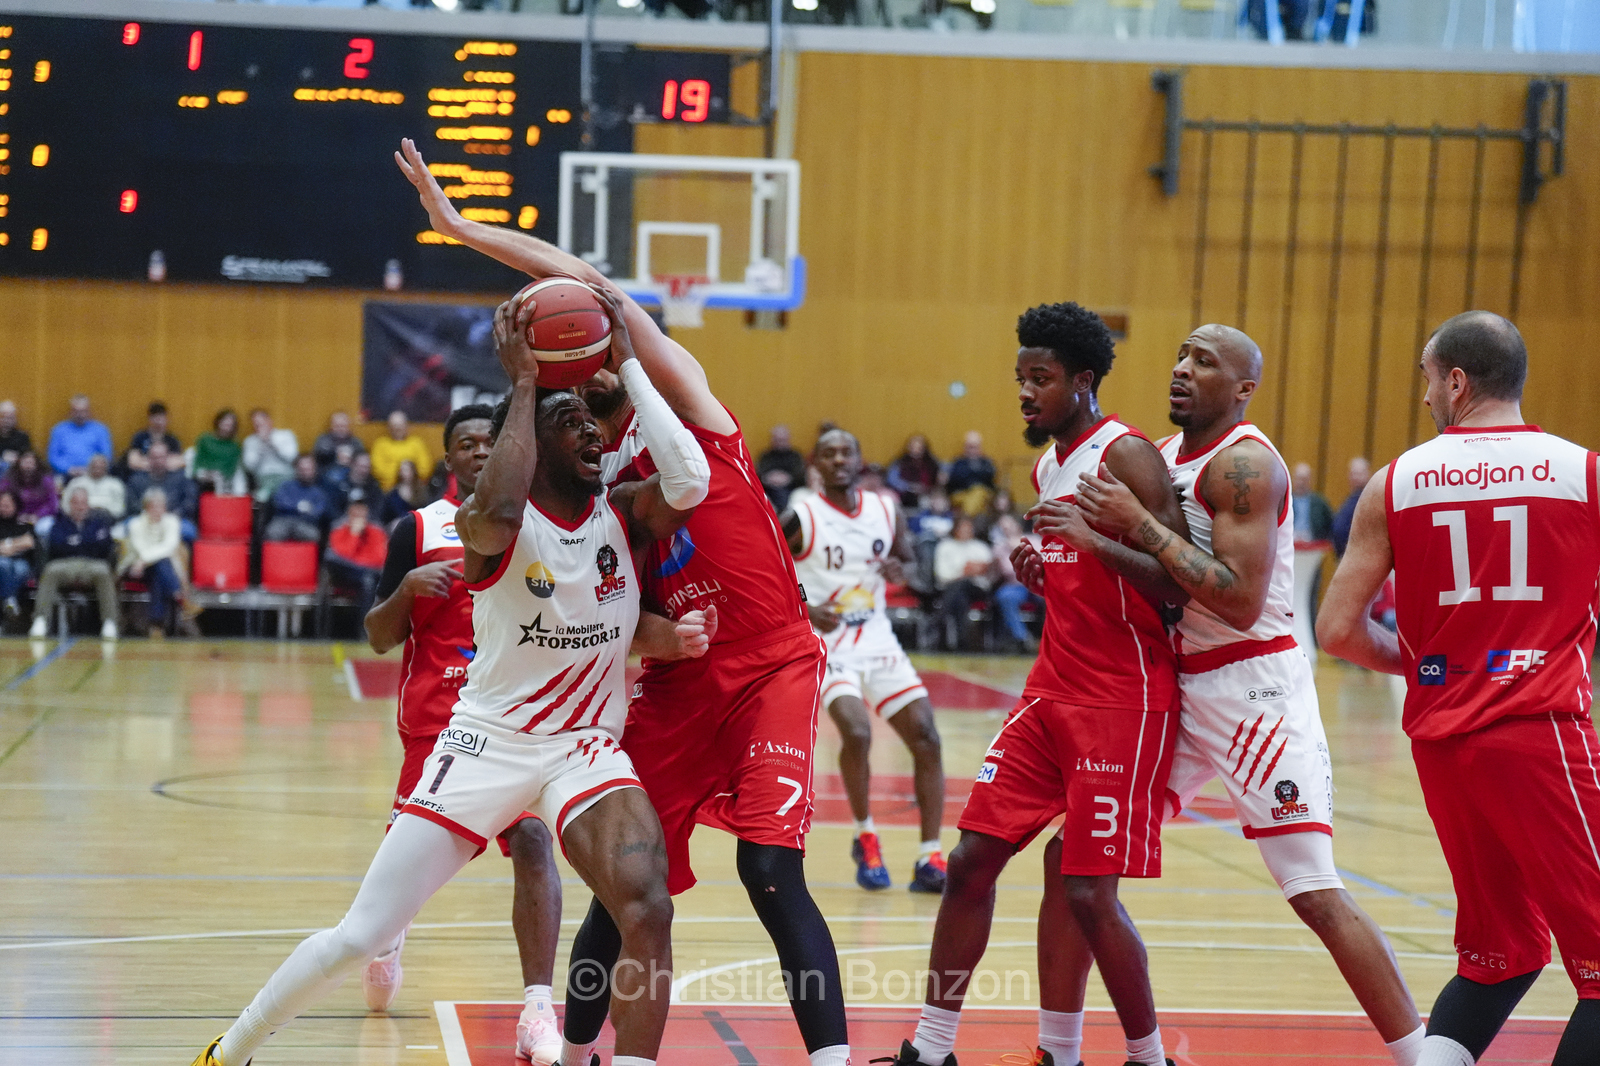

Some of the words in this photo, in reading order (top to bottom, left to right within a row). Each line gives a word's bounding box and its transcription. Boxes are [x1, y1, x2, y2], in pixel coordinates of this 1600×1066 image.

[187, 30, 203, 71] 1
[344, 38, 374, 79] 2
[662, 79, 711, 122] 19
[1414, 462, 1524, 490] mladjan
[1531, 459, 1556, 483] d.
[825, 545, 844, 570] 13
[1431, 504, 1544, 606] 11
[664, 578, 722, 618] SPINELLI
[555, 625, 565, 635] la
[1420, 664, 1442, 676] CQ
[762, 740, 806, 760] Axion
[1081, 757, 1124, 773] Axion
[428, 754, 455, 795] 1
[775, 775, 803, 817] 7
[1271, 803, 1309, 820] LIONS
[1091, 795, 1120, 838] 3
